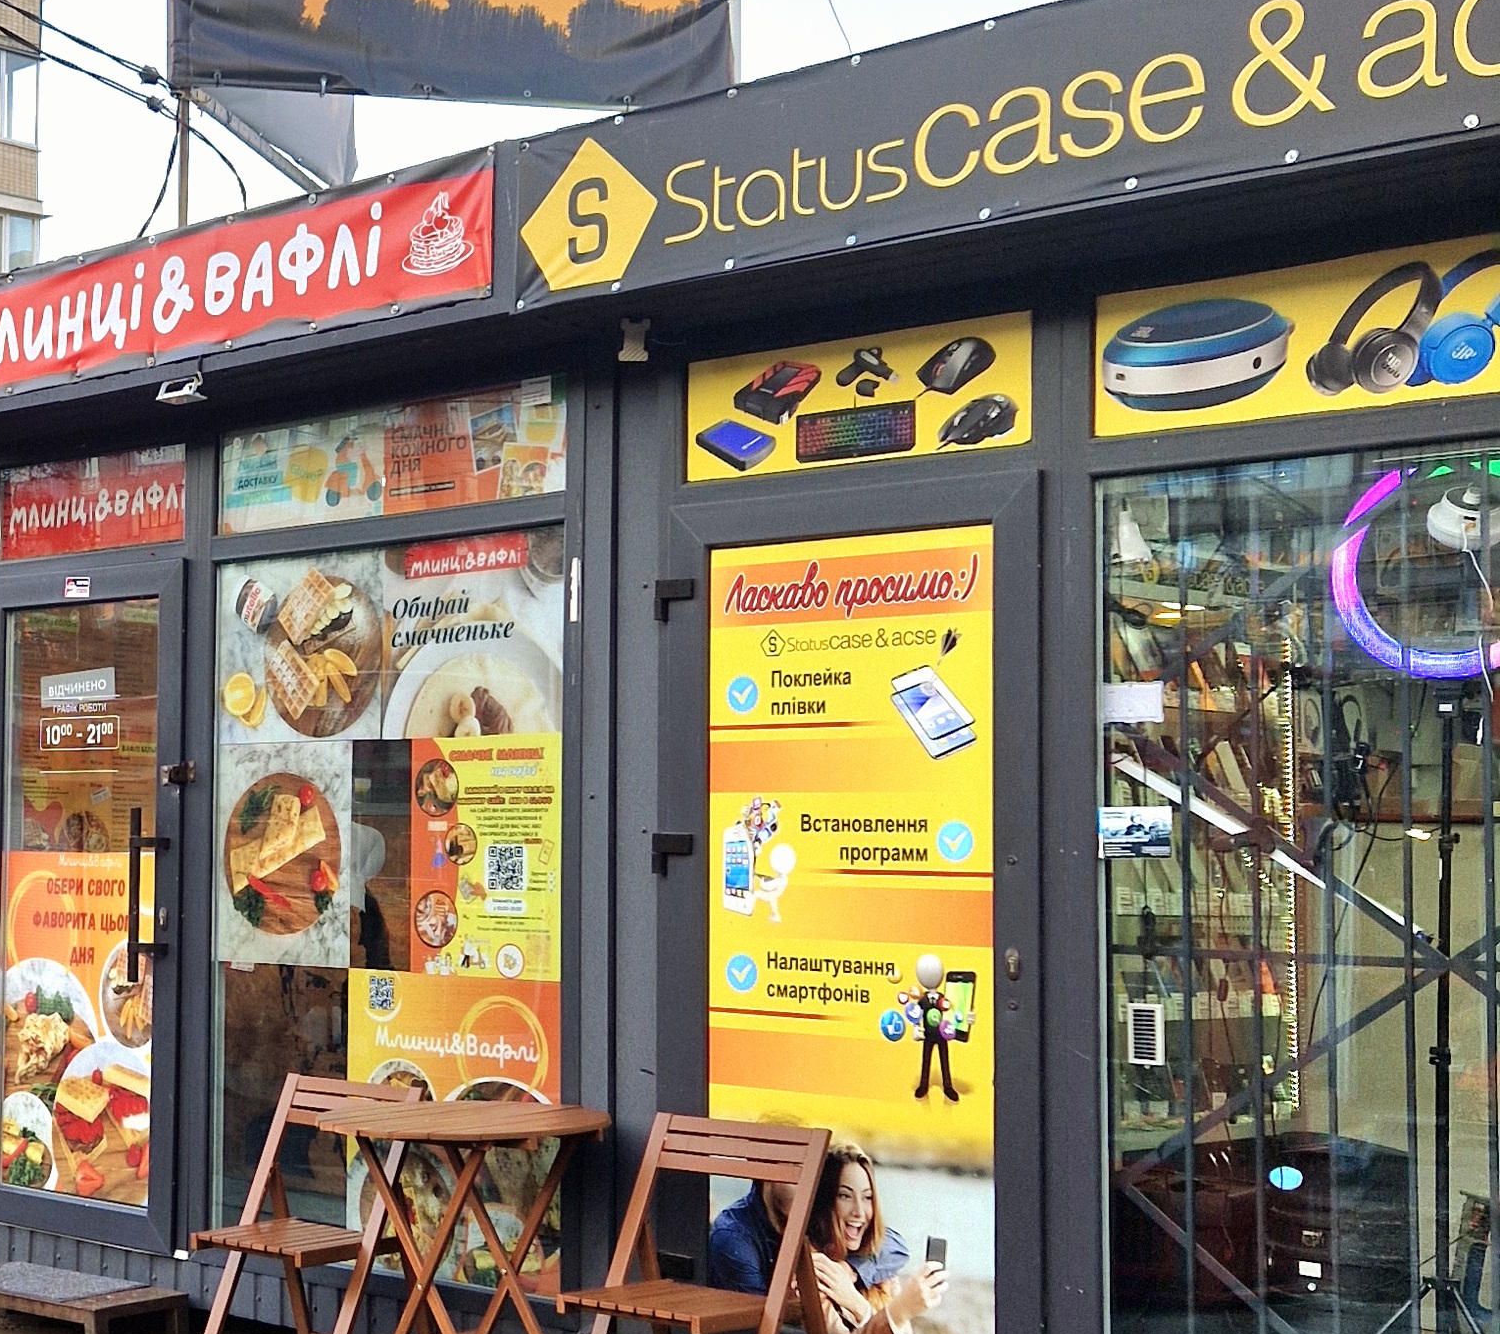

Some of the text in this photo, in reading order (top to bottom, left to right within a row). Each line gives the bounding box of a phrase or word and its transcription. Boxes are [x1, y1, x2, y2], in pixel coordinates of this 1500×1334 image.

[389, 457, 422, 478] ДНЯ
[724, 560, 830, 615] Ласкаво
[392, 589, 471, 621] Обирай
[391, 617, 516, 649] смачненьке
[875, 628, 890, 648] &
[891, 628, 938, 648] acse
[48, 678, 107, 698] ВІДЧИНЕНО
[770, 668, 852, 689] Поклейка
[770, 697, 826, 716] плівки
[800, 814, 928, 834] Встановлення
[839, 846, 929, 866] программ
[46, 877, 126, 897] ОБЕРИ СВОГО
[32, 910, 97, 932] ФАВОРИТА
[69, 947, 95, 966] ДНЯ
[766, 950, 896, 979] Налаштування
[766, 982, 871, 1006] смартфонів
